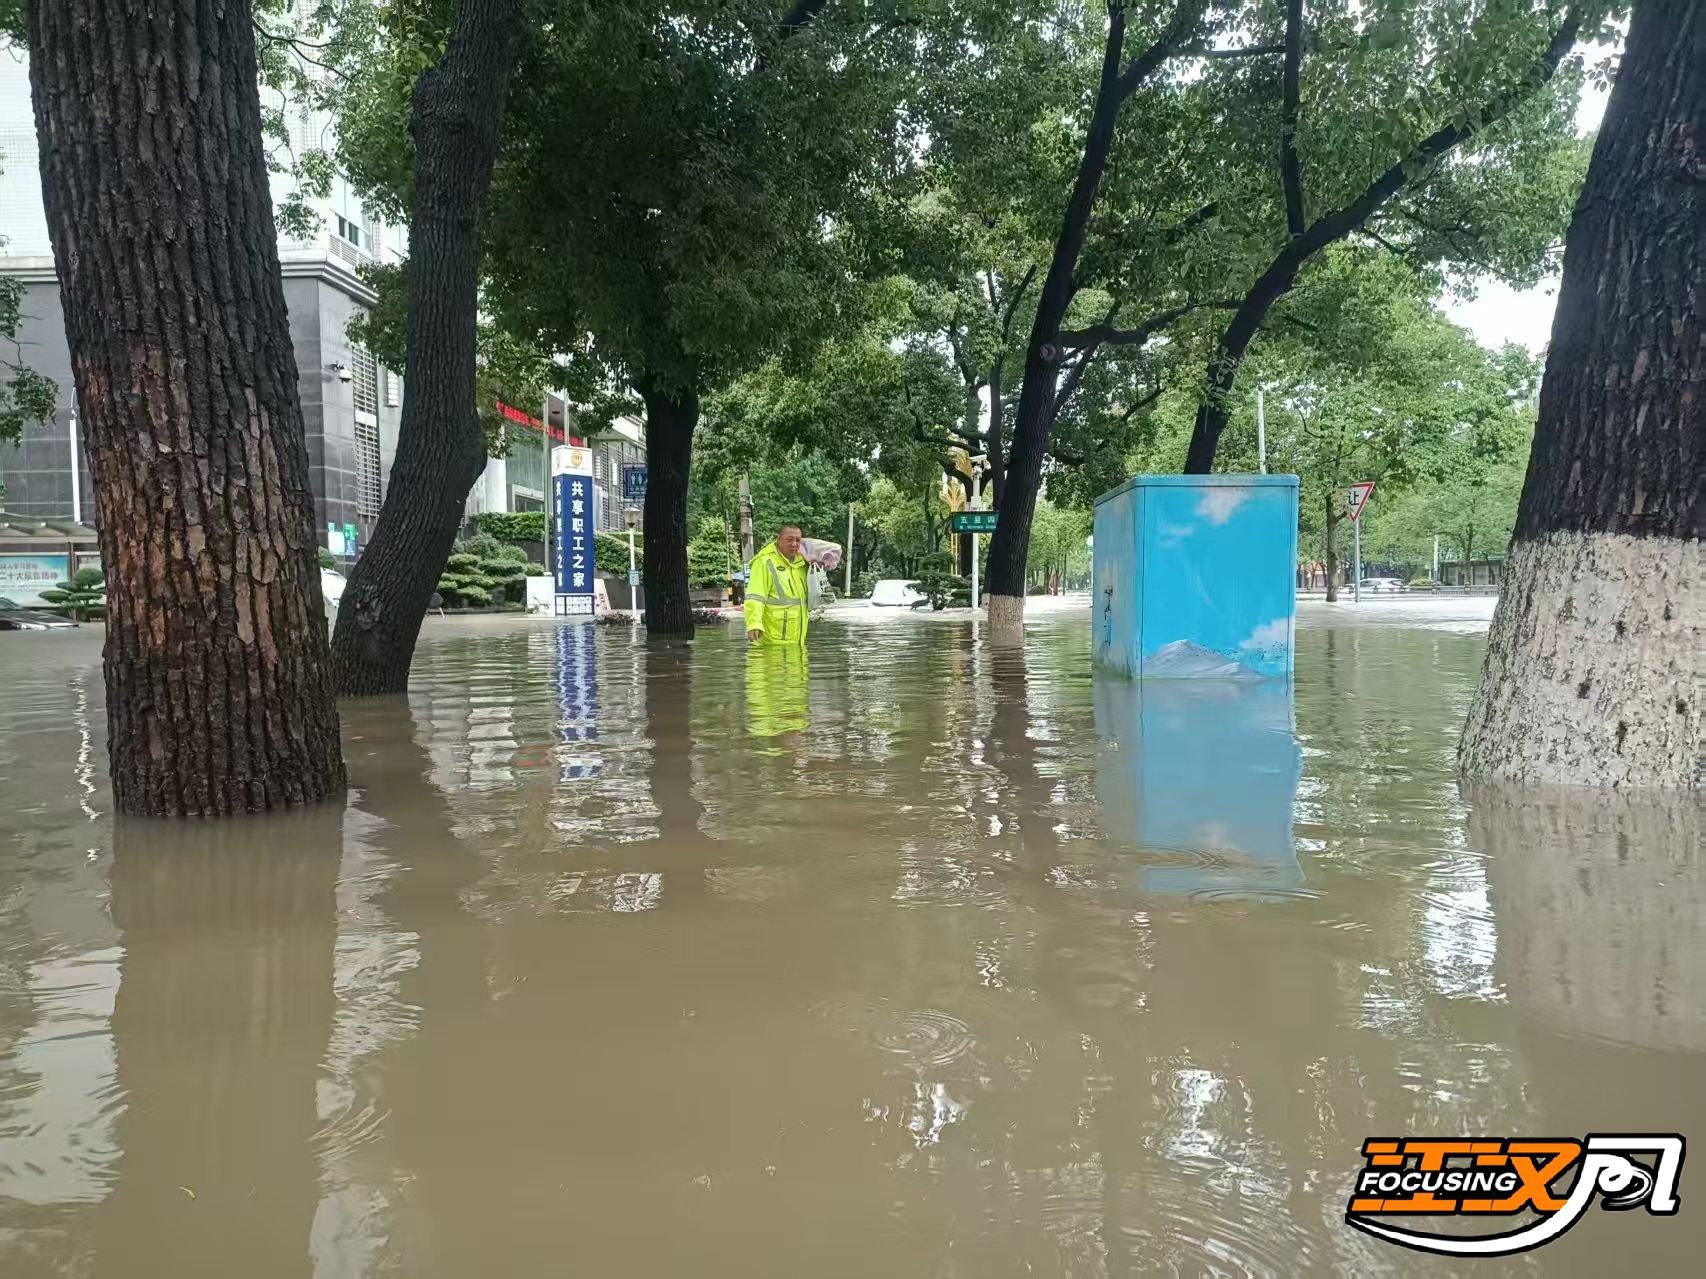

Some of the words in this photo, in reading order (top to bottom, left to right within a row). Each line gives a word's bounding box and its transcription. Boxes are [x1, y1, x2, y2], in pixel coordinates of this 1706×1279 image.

[1347, 491, 1359, 505] 让
[572, 481, 584, 587] 共享职工之家
